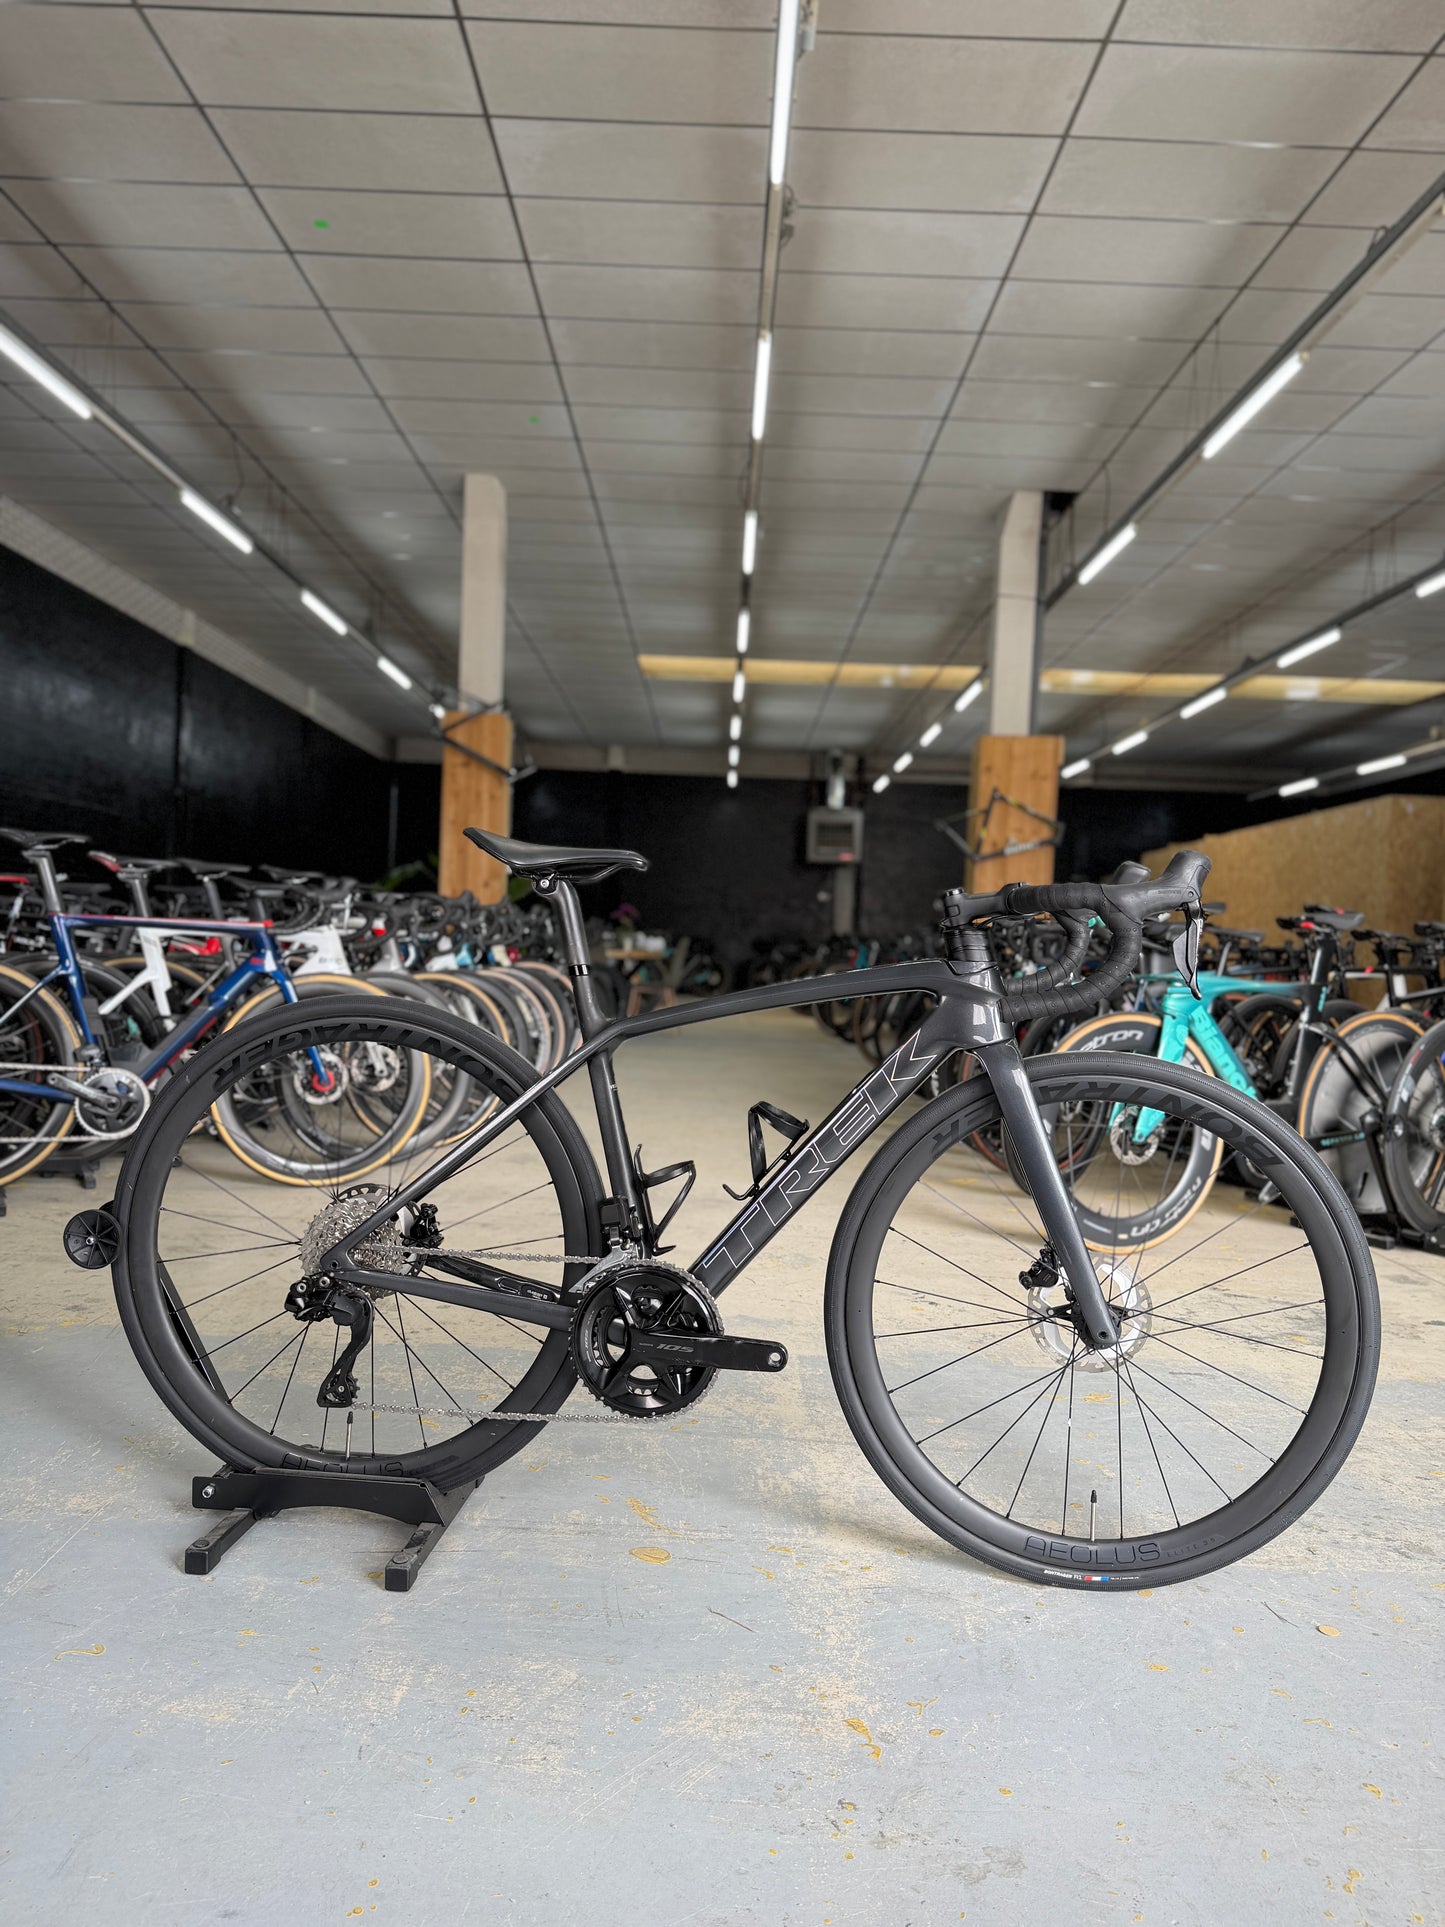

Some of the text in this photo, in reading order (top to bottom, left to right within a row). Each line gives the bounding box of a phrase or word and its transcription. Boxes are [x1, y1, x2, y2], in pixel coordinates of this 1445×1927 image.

[1079, 1029, 1144, 1051] etron
[1190, 1004, 1257, 1100] Bianc
[702, 1028, 938, 1269] TREK
[930, 1080, 1287, 1169] BONTRAER
[656, 1342, 695, 1354] 105
[1025, 1535, 1161, 1565] AEOLUS
